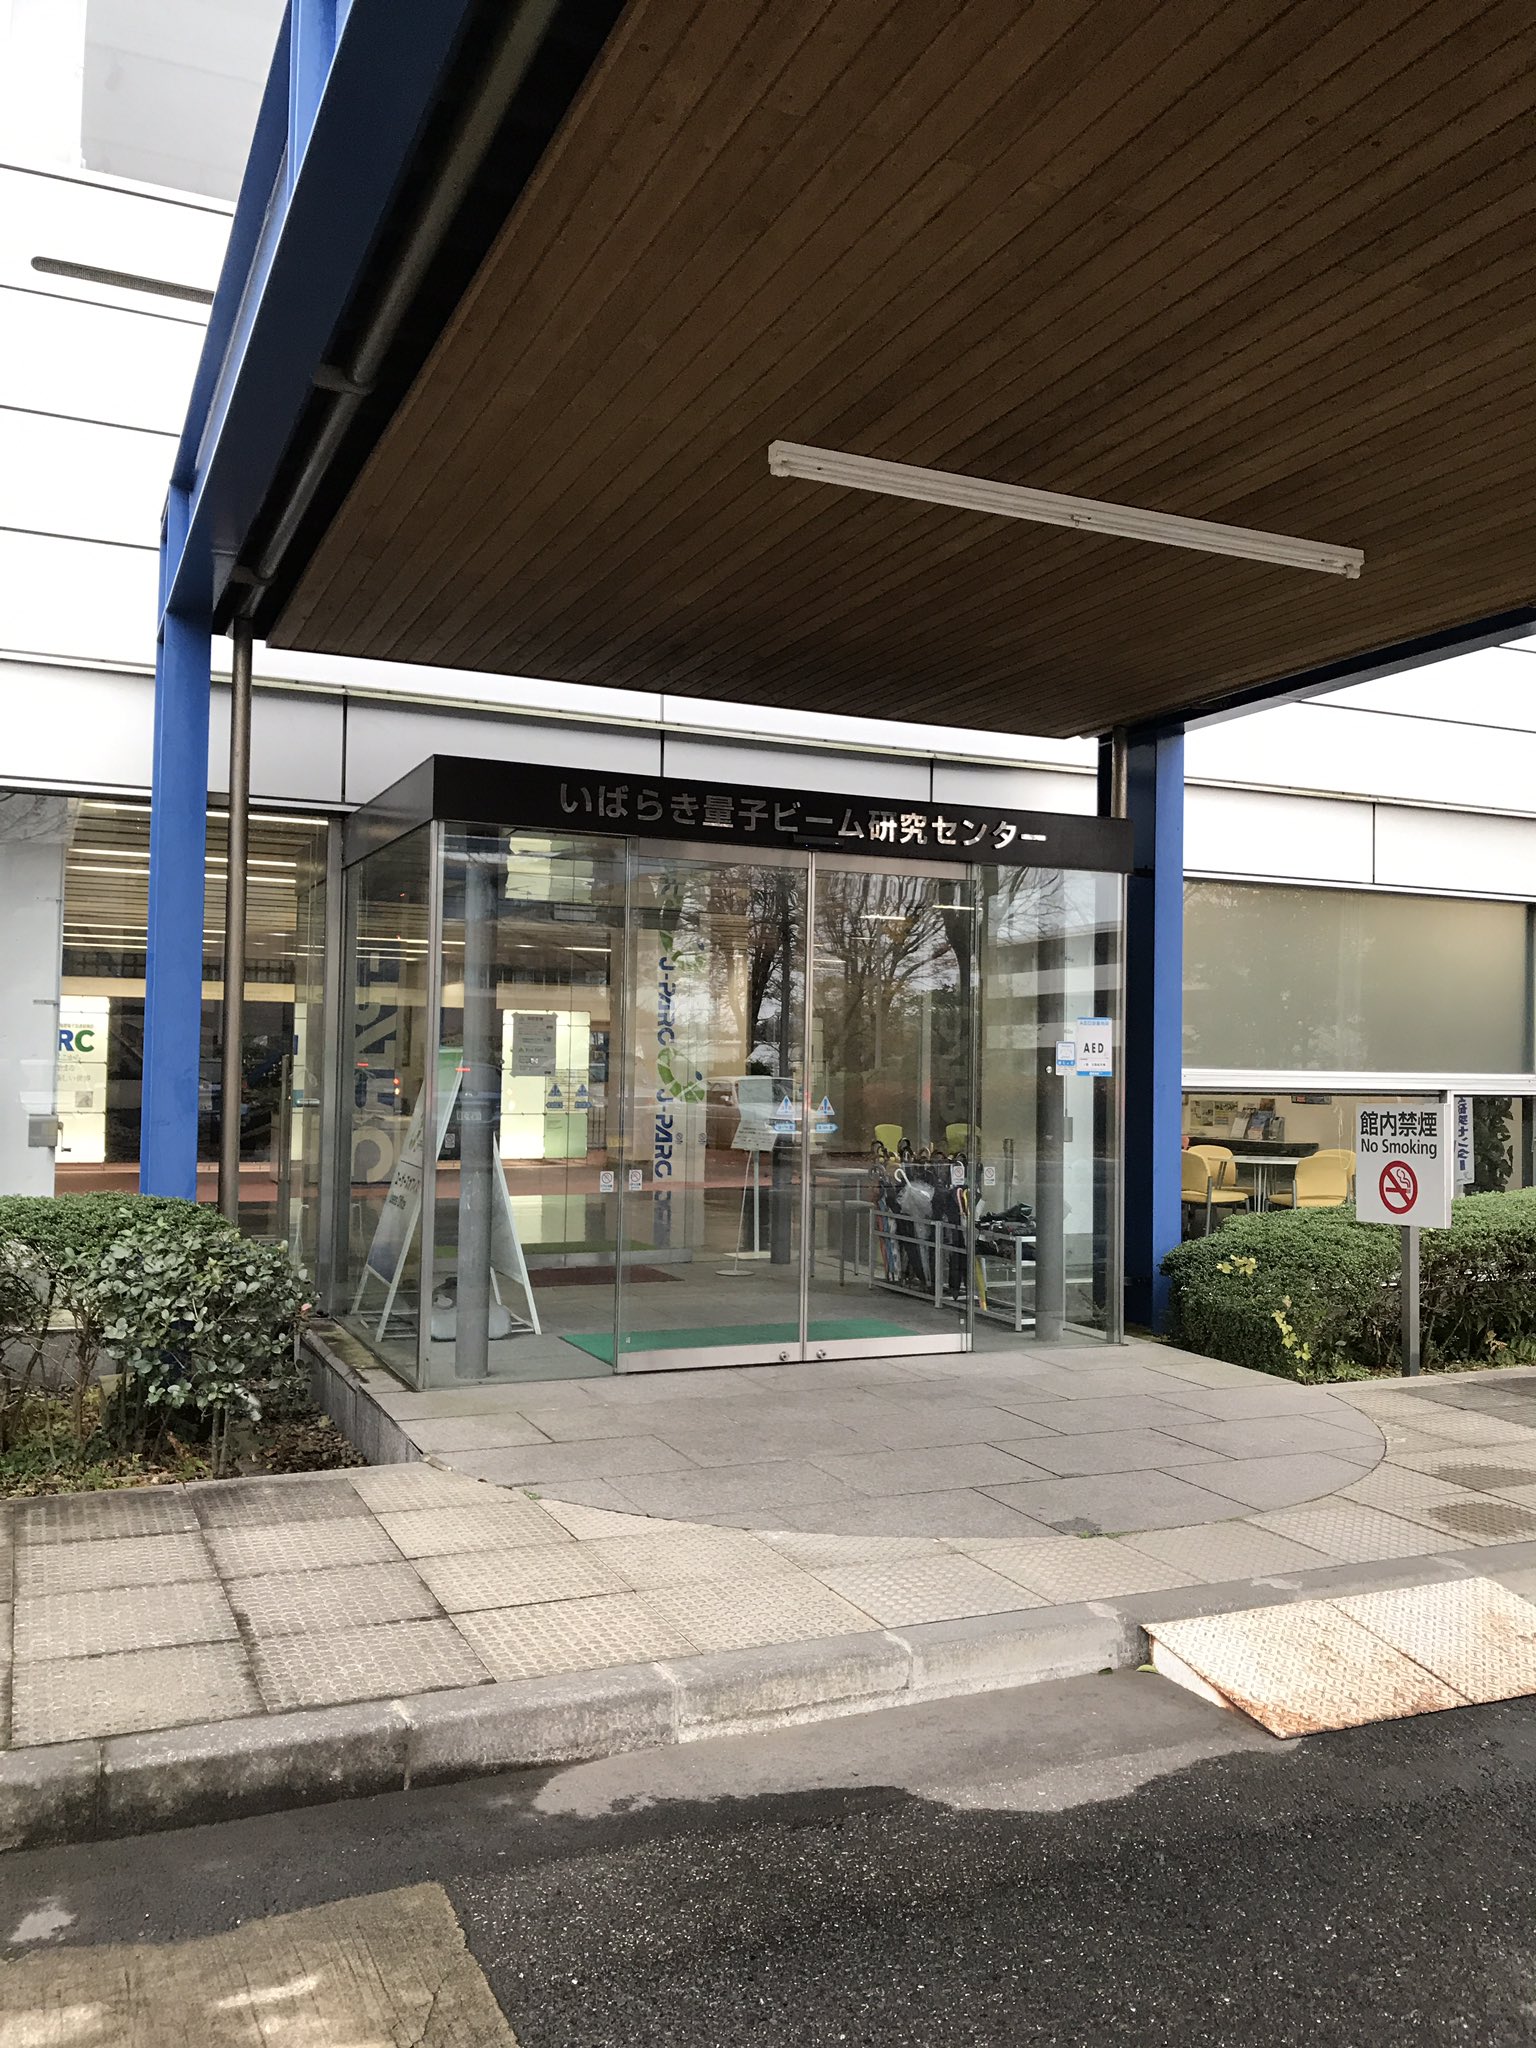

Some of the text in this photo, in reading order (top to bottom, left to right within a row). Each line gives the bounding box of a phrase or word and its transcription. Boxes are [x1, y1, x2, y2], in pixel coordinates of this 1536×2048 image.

[560, 782, 1047, 849] いばらき量子ビーム研究センター
[1083, 1042, 1105, 1054] AED
[654, 1087, 674, 1179] J-PARC
[1360, 1110, 1438, 1138] 館内禁煙
[1360, 1138, 1438, 1160] No Smoking
